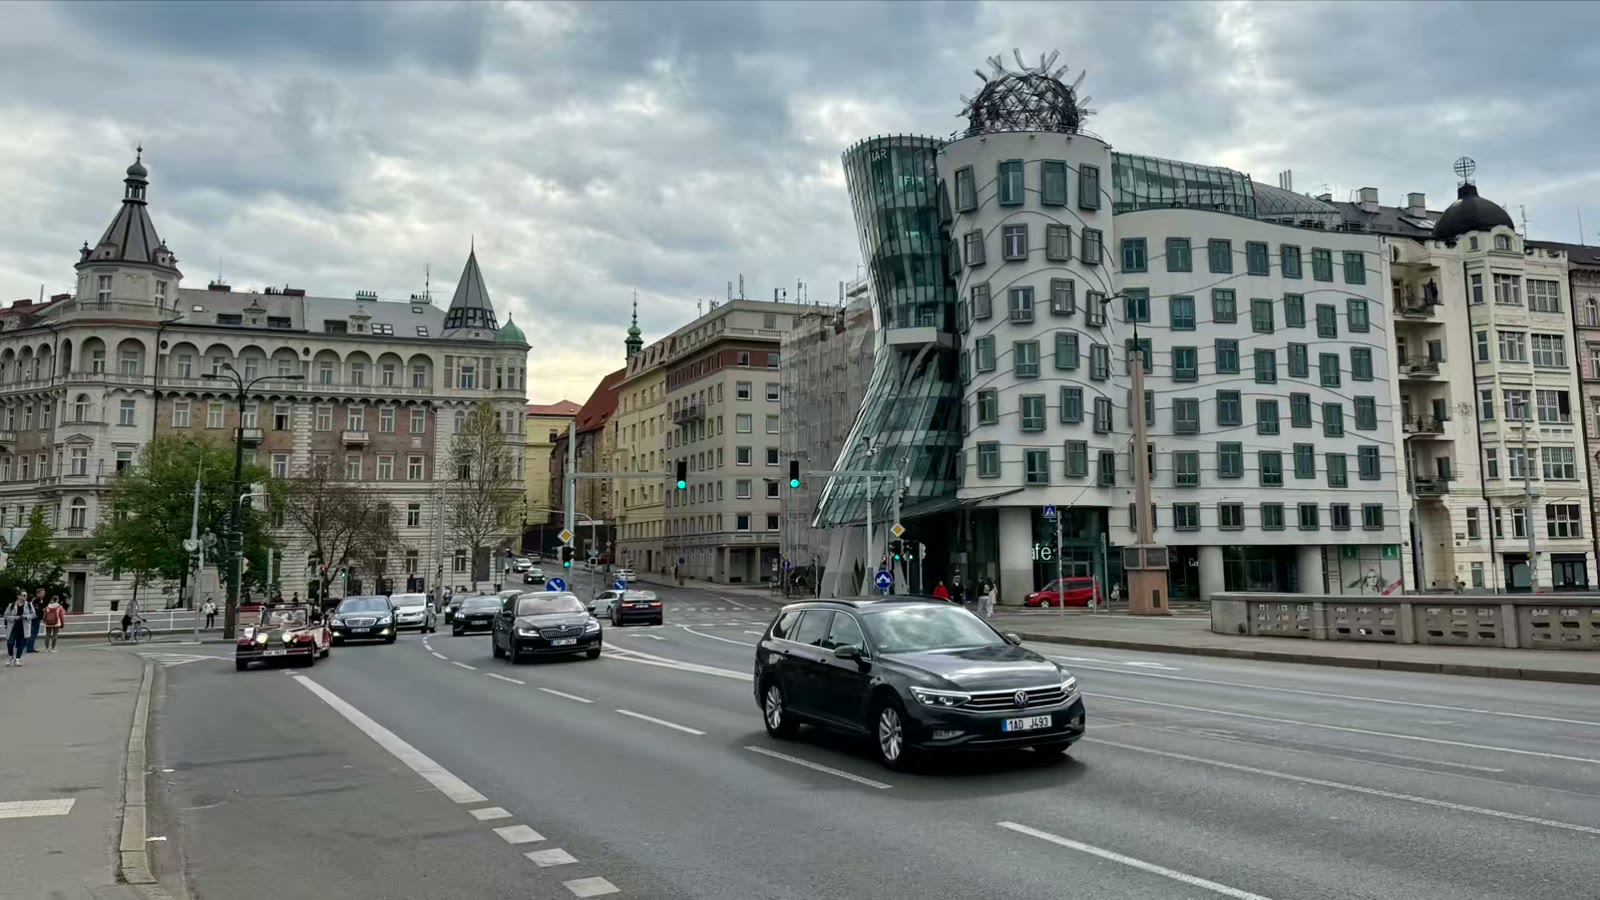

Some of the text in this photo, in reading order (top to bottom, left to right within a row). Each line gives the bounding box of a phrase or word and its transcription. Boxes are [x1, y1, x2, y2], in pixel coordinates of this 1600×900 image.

[1032, 541, 1051, 561] afé
[1188, 557, 1199, 567] Ca
[1008, 716, 1049, 731] 1AD J493
